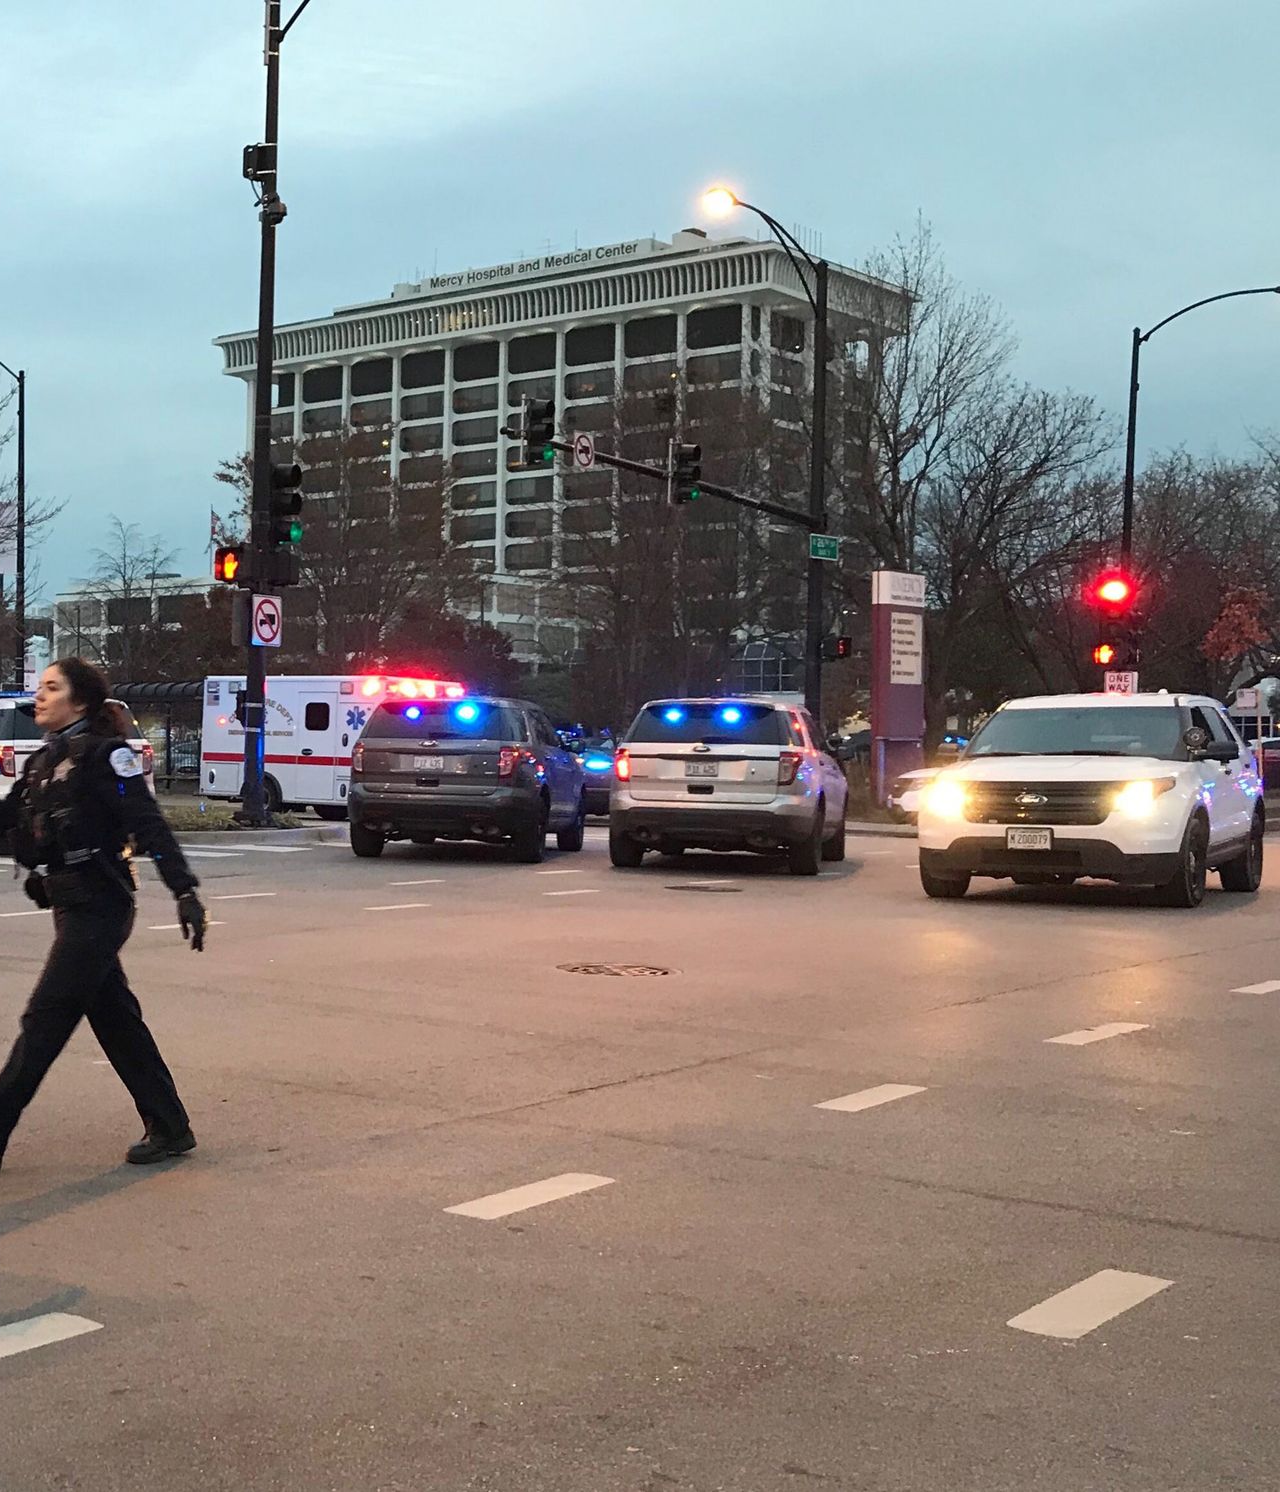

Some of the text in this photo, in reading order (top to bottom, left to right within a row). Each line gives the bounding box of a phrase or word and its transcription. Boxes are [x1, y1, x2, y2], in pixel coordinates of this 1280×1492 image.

[430, 243, 638, 289] Mercy Hospital and Medical Center
[1108, 675, 1129, 683] ONE
[1108, 684, 1130, 693] WAY
